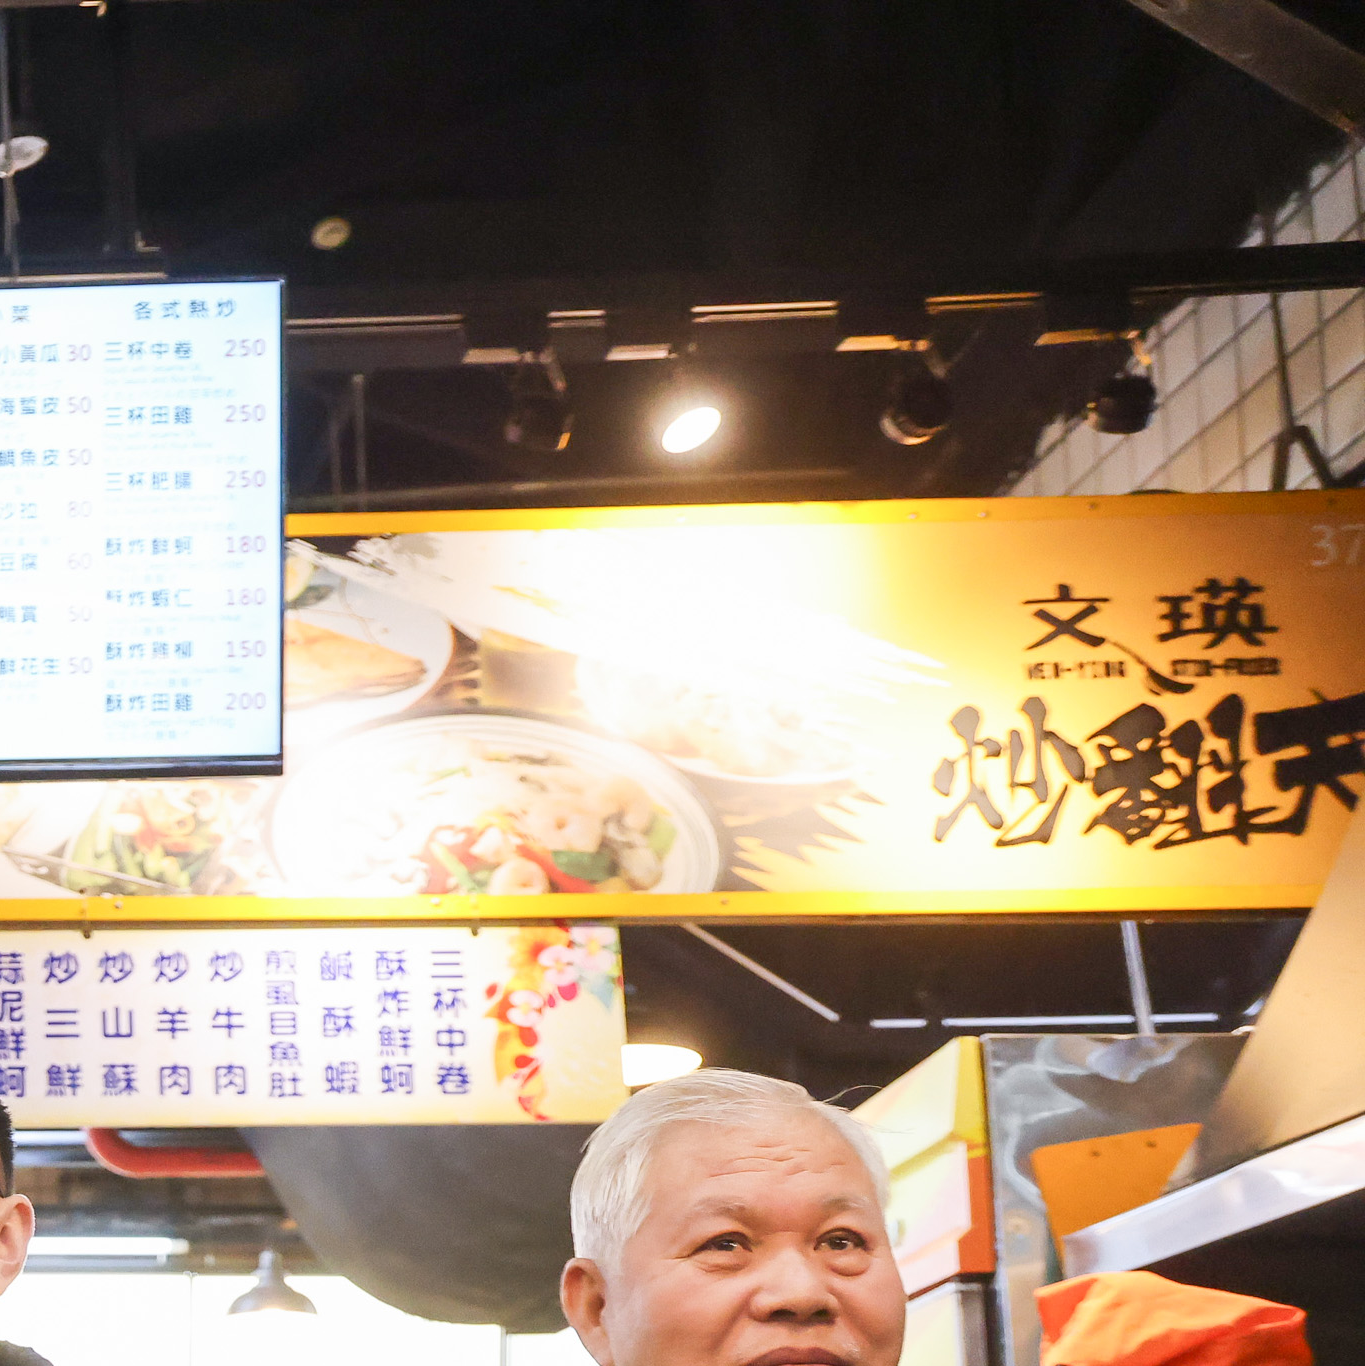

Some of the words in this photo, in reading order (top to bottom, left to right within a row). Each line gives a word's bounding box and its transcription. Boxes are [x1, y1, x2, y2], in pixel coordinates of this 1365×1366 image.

[1020, 576, 1280, 650] 文瑛
[43, 950, 82, 1097] 炒三鮮
[99, 950, 138, 1097] 炒山蘇
[155, 950, 192, 1096] 炒羊肉
[209, 950, 247, 1095] 炒牛肉
[265, 949, 303, 1098] 煎虱目魚肚
[320, 951, 359, 1096] 鹹酥蝦
[375, 949, 414, 1096] 酥炸鮮蚵
[430, 949, 471, 1096] 三杯中卷
